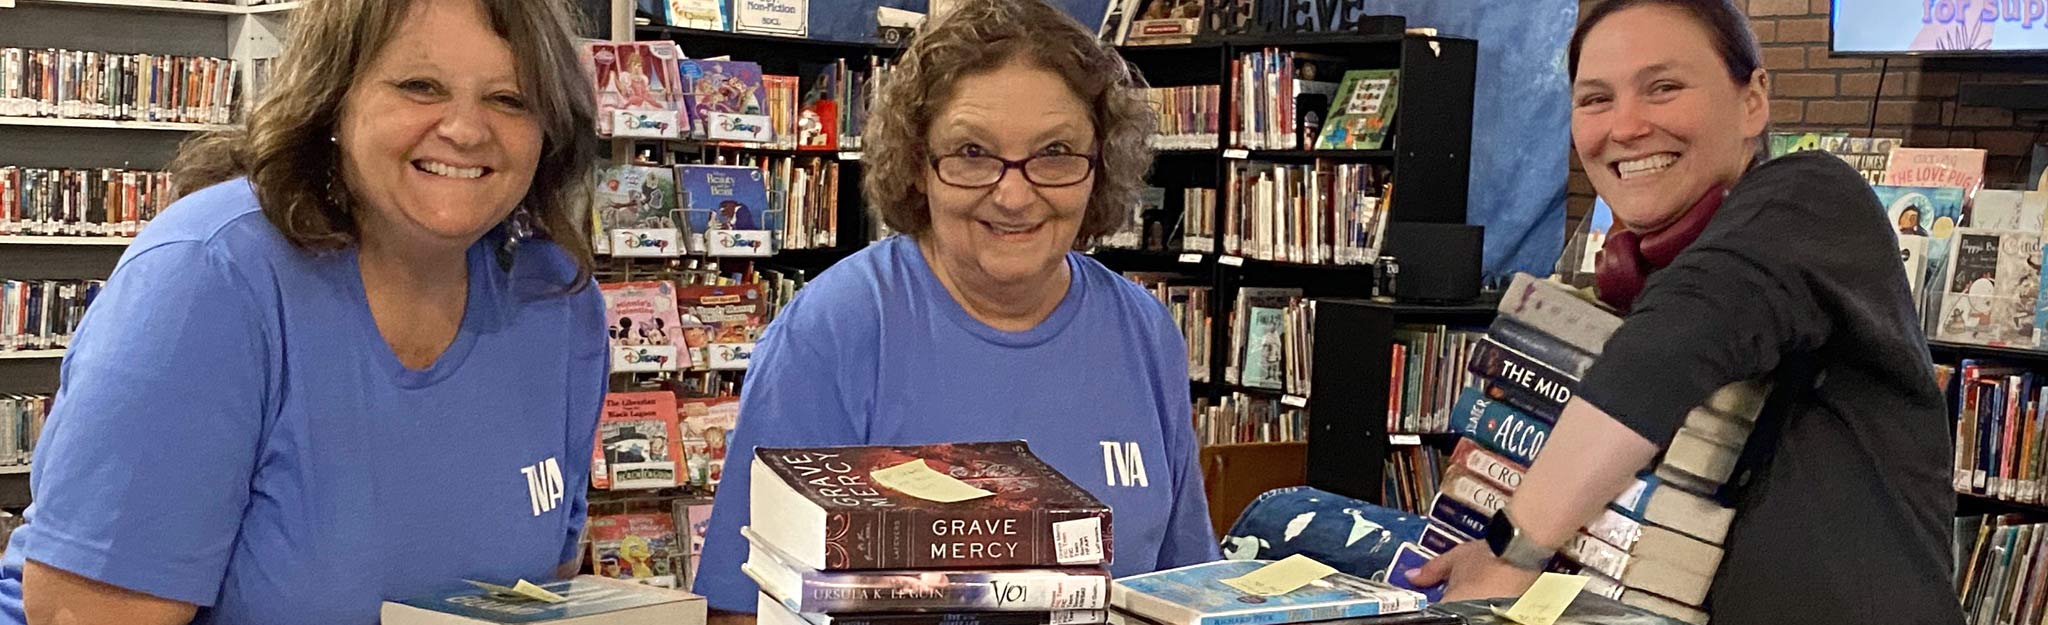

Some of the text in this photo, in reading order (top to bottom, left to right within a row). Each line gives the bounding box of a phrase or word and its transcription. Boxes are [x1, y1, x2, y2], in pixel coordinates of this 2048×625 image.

[1981, 0, 2048, 30] sup
[622, 112, 669, 135] Disney
[718, 114, 763, 137] Disney
[1916, 167, 1946, 184] LOVE
[622, 231, 669, 253] Disney
[718, 231, 762, 254] Disney
[622, 347, 669, 369] Disney
[1501, 360, 1571, 404] THE MID
[1493, 414, 1545, 461] ACCO
[1100, 441, 1149, 487] TVA
[1487, 461, 1522, 488] CRO
[520, 457, 565, 517] TVA
[782, 453, 861, 507] GRAVE
[811, 452, 897, 508] MERCY
[932, 518, 1018, 536] GRAVE
[930, 542, 1019, 560] MERCY
[813, 588, 870, 600] URSULA
